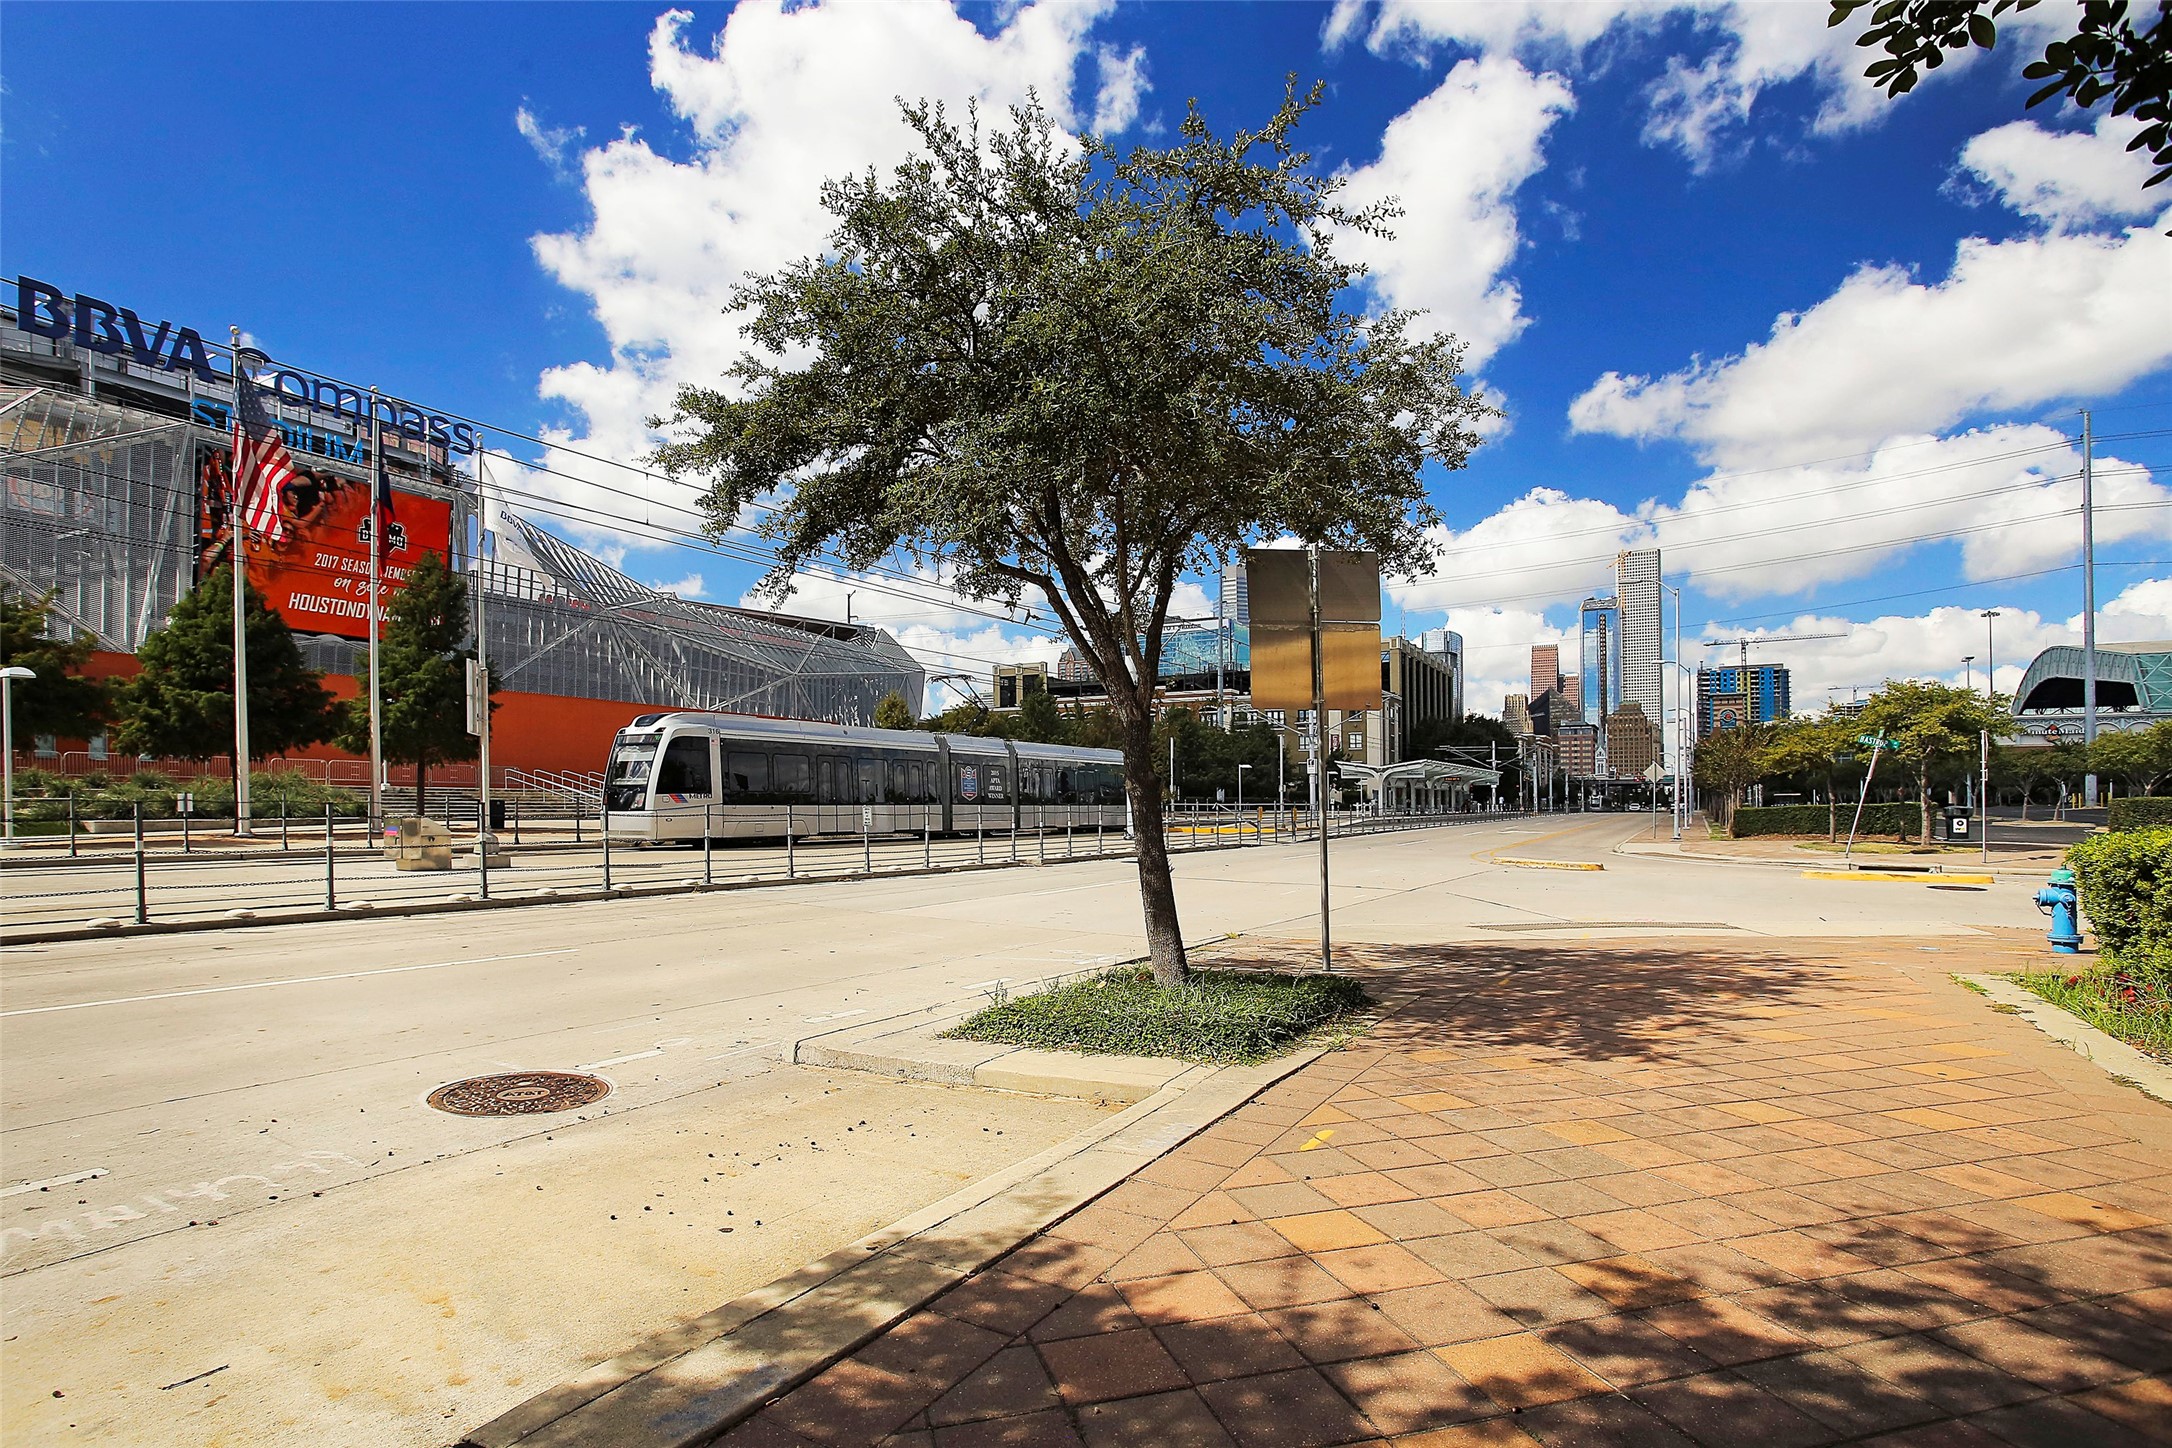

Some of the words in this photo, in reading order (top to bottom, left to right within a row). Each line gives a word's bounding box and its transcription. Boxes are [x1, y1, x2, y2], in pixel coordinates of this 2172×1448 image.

[17, 274, 216, 384] BBVA
[191, 399, 364, 465] STIUM
[314, 552, 340, 569] 2017
[341, 557, 371, 575] SEASO
[333, 577, 352, 593] on
[355, 579, 389, 596] sae
[2058, 727, 2085, 735] Maid
